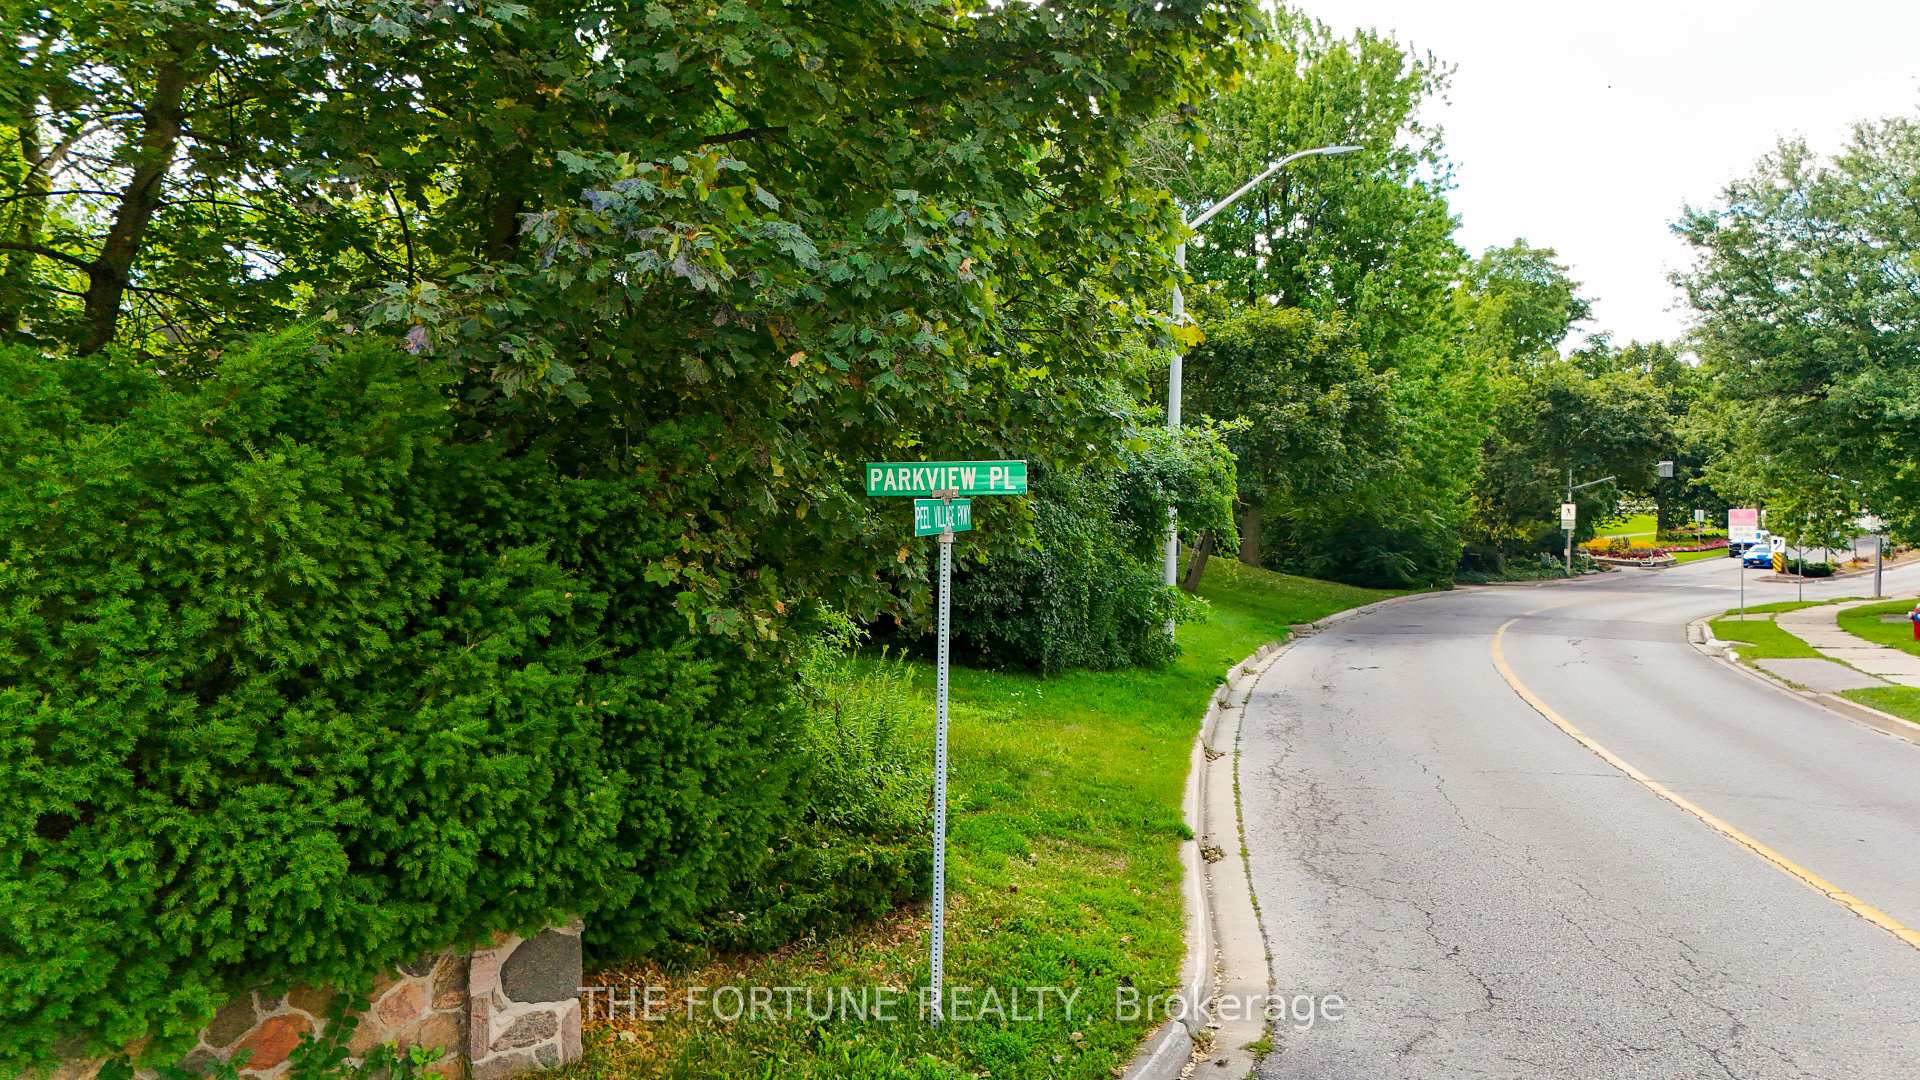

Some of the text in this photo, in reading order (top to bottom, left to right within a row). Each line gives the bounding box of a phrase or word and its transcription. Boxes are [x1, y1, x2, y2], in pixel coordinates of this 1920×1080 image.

[870, 466, 1016, 491] PARKVIEW PL
[915, 506, 931, 529] PEEL
